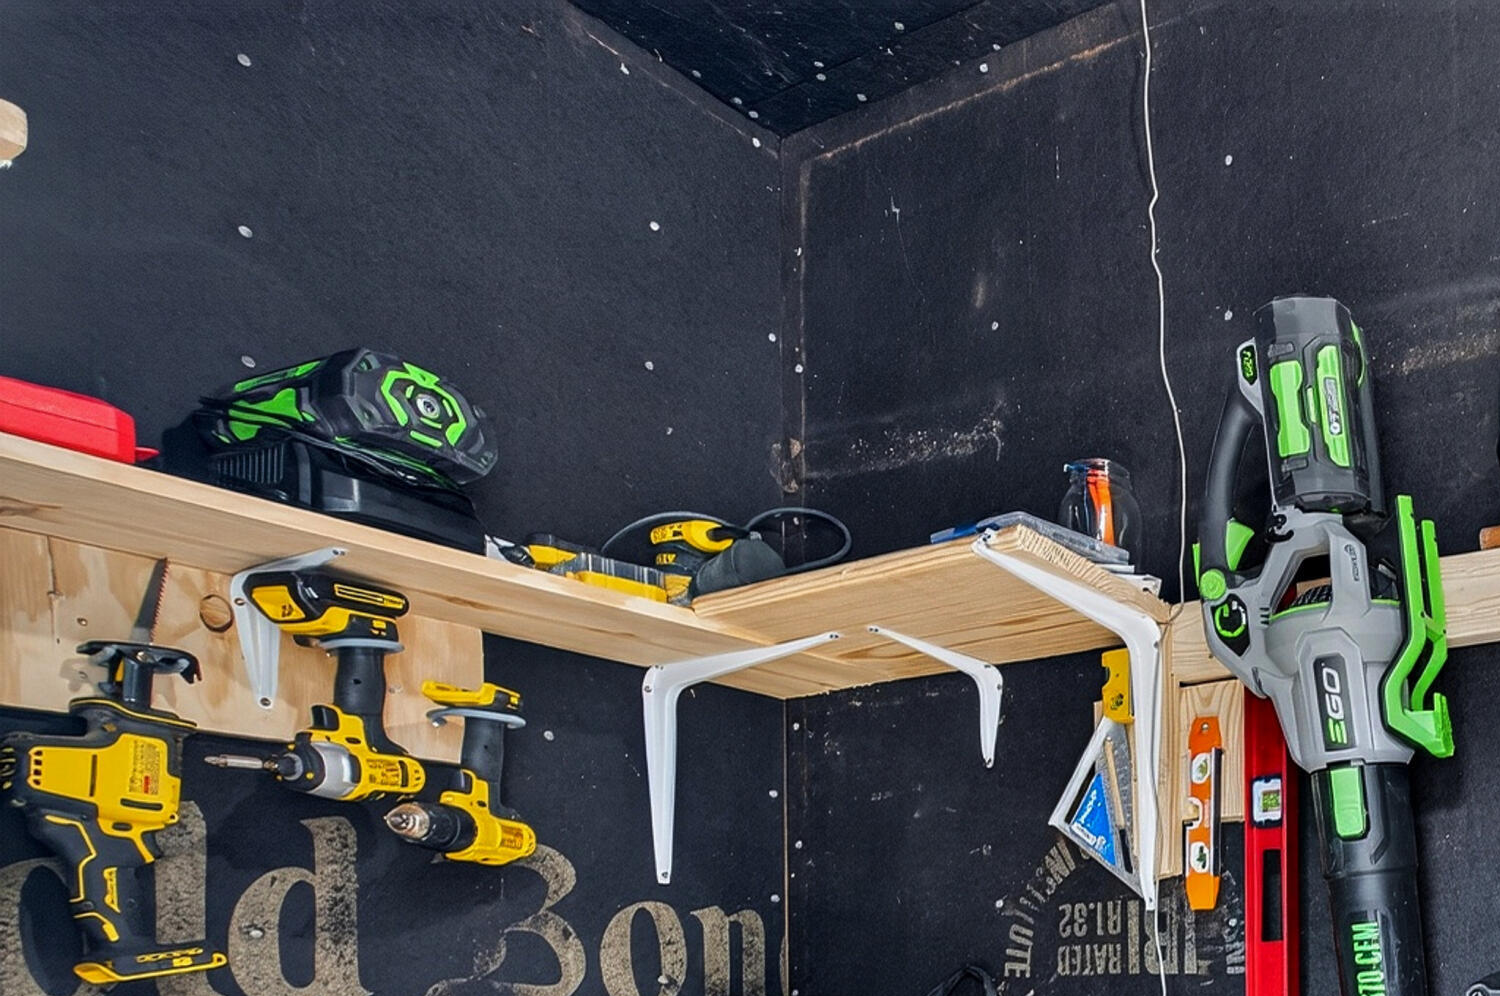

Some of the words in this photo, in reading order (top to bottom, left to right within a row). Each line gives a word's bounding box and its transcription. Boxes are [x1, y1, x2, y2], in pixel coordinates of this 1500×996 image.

[1321, 667, 1348, 744] EGO
[1057, 943, 1122, 977] RATED
[1351, 921, 1384, 965] CFM
